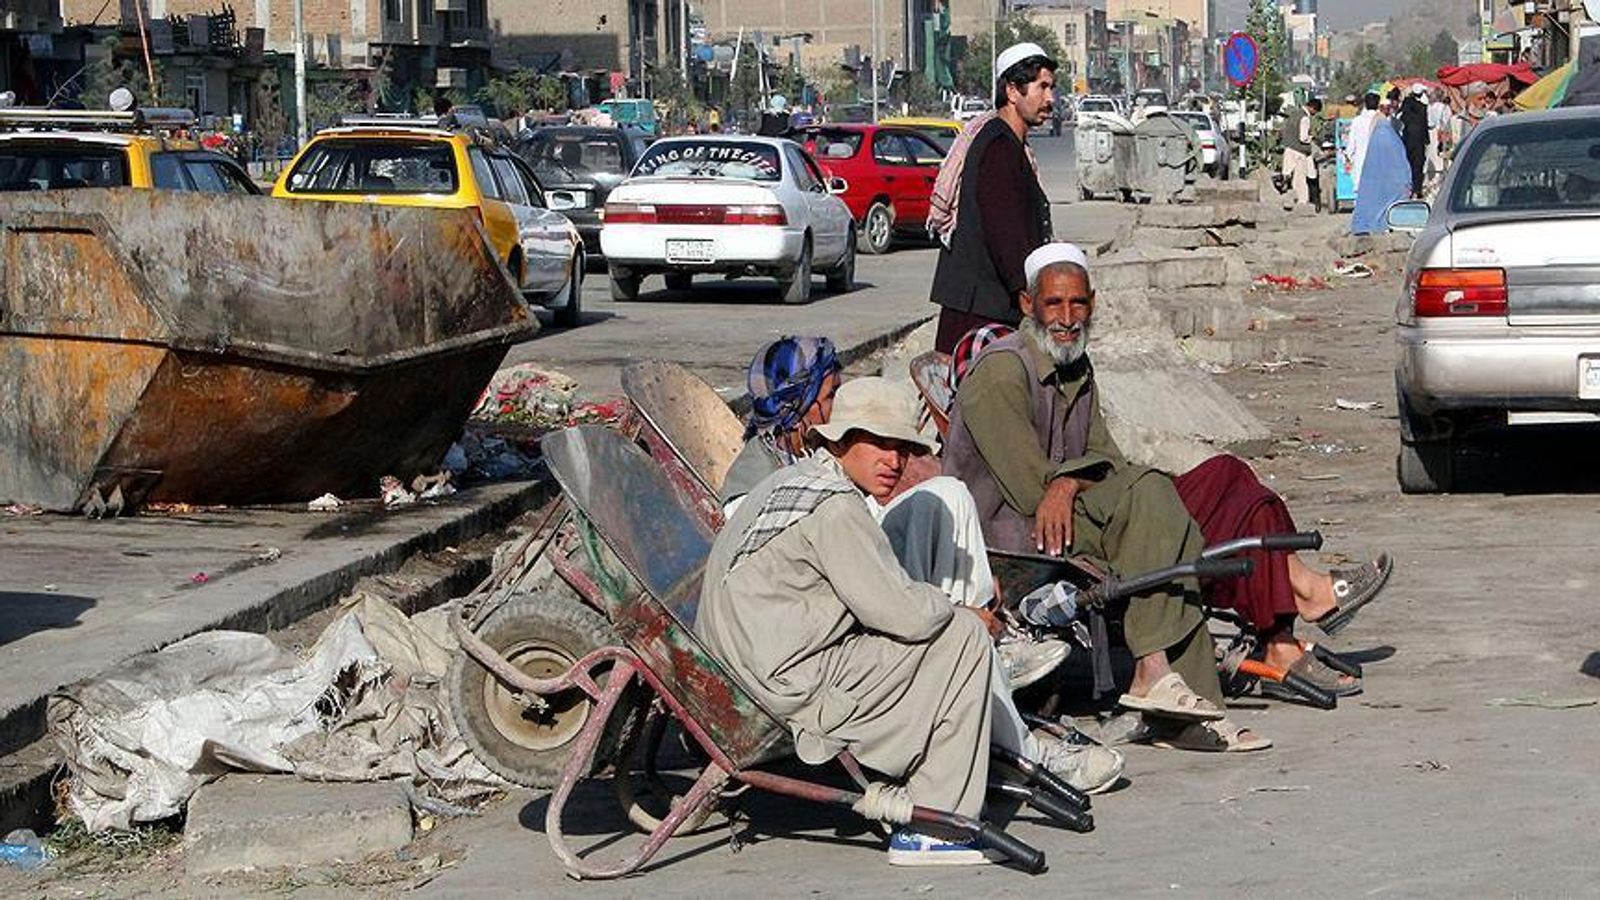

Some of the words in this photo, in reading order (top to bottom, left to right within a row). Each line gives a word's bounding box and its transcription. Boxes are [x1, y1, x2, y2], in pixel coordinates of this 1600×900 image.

[638, 150, 679, 174] KING
[683, 146, 705, 158] OF
[709, 147, 743, 159] THE
